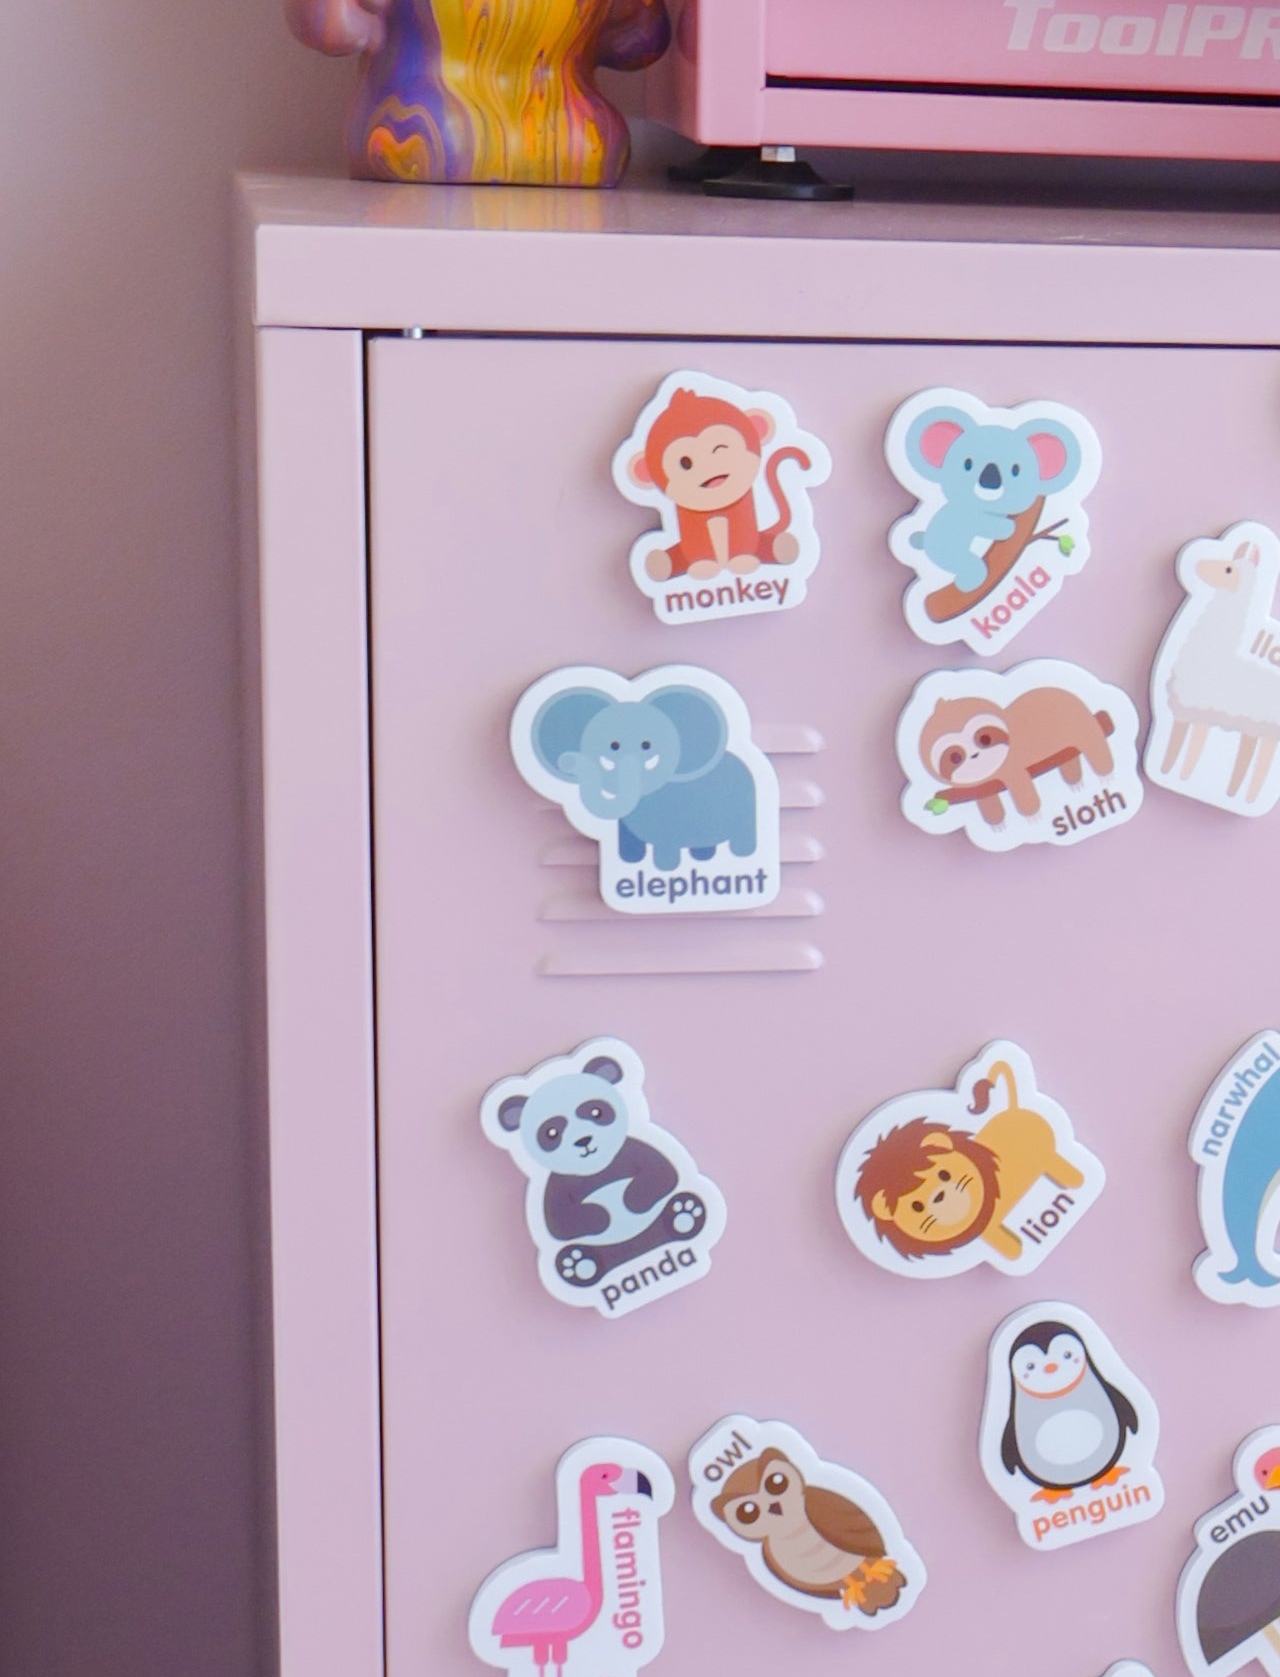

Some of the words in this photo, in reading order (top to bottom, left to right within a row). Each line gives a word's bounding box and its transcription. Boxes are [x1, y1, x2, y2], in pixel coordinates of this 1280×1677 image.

[665, 576, 790, 613] monkey
[970, 564, 1052, 639] koala
[1051, 788, 1127, 837] sloth
[615, 867, 768, 903] elephant
[1020, 1191, 1075, 1244] lion
[601, 1245, 697, 1311] panda
[703, 1430, 753, 1485] owl
[1031, 1480, 1151, 1541] penguin
[1209, 1495, 1271, 1546] emu
[611, 1507, 643, 1650] flamingo
